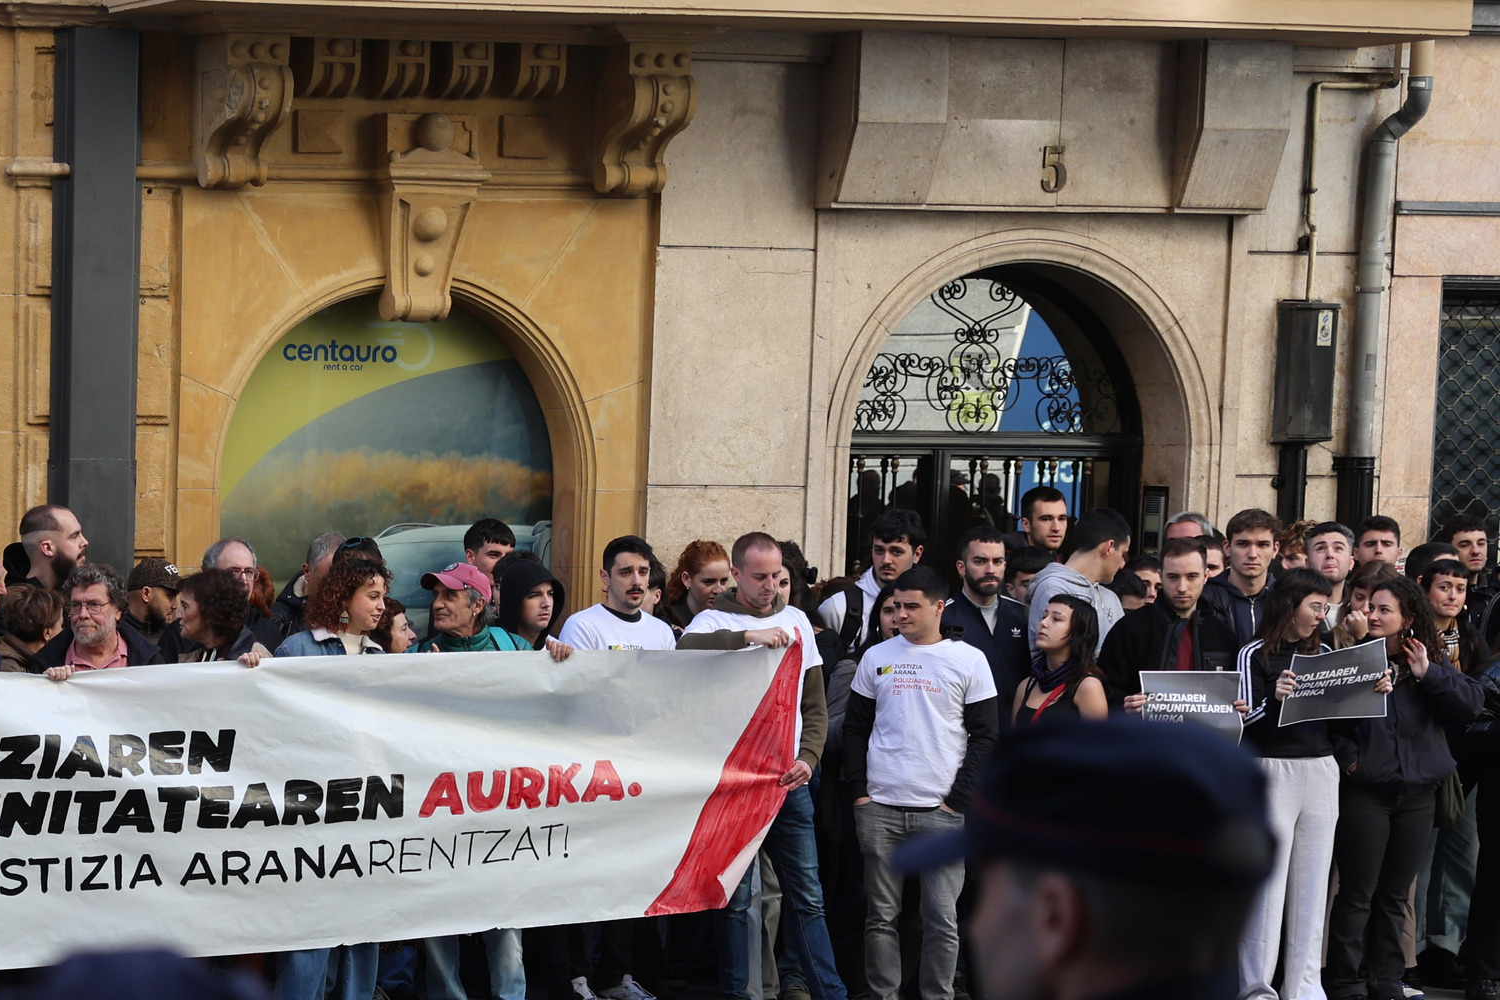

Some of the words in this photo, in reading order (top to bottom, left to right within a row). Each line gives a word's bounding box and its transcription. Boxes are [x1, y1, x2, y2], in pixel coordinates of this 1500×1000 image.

[1041, 146, 1067, 193] 5
[283, 340, 397, 363] centauro
[323, 363, 340, 371] rent
[1294, 672, 1383, 690] NPUNITATEAREN
[1295, 666, 1358, 682] POLIZIAREN
[1147, 693, 1206, 702] POLIZIAREN
[1287, 688, 1325, 700] AURKA
[1146, 704, 1233, 713] INPUNITATEAREN
[419, 760, 642, 818] AURKA.
[180, 824, 569, 887] ARANARENTZAT!
